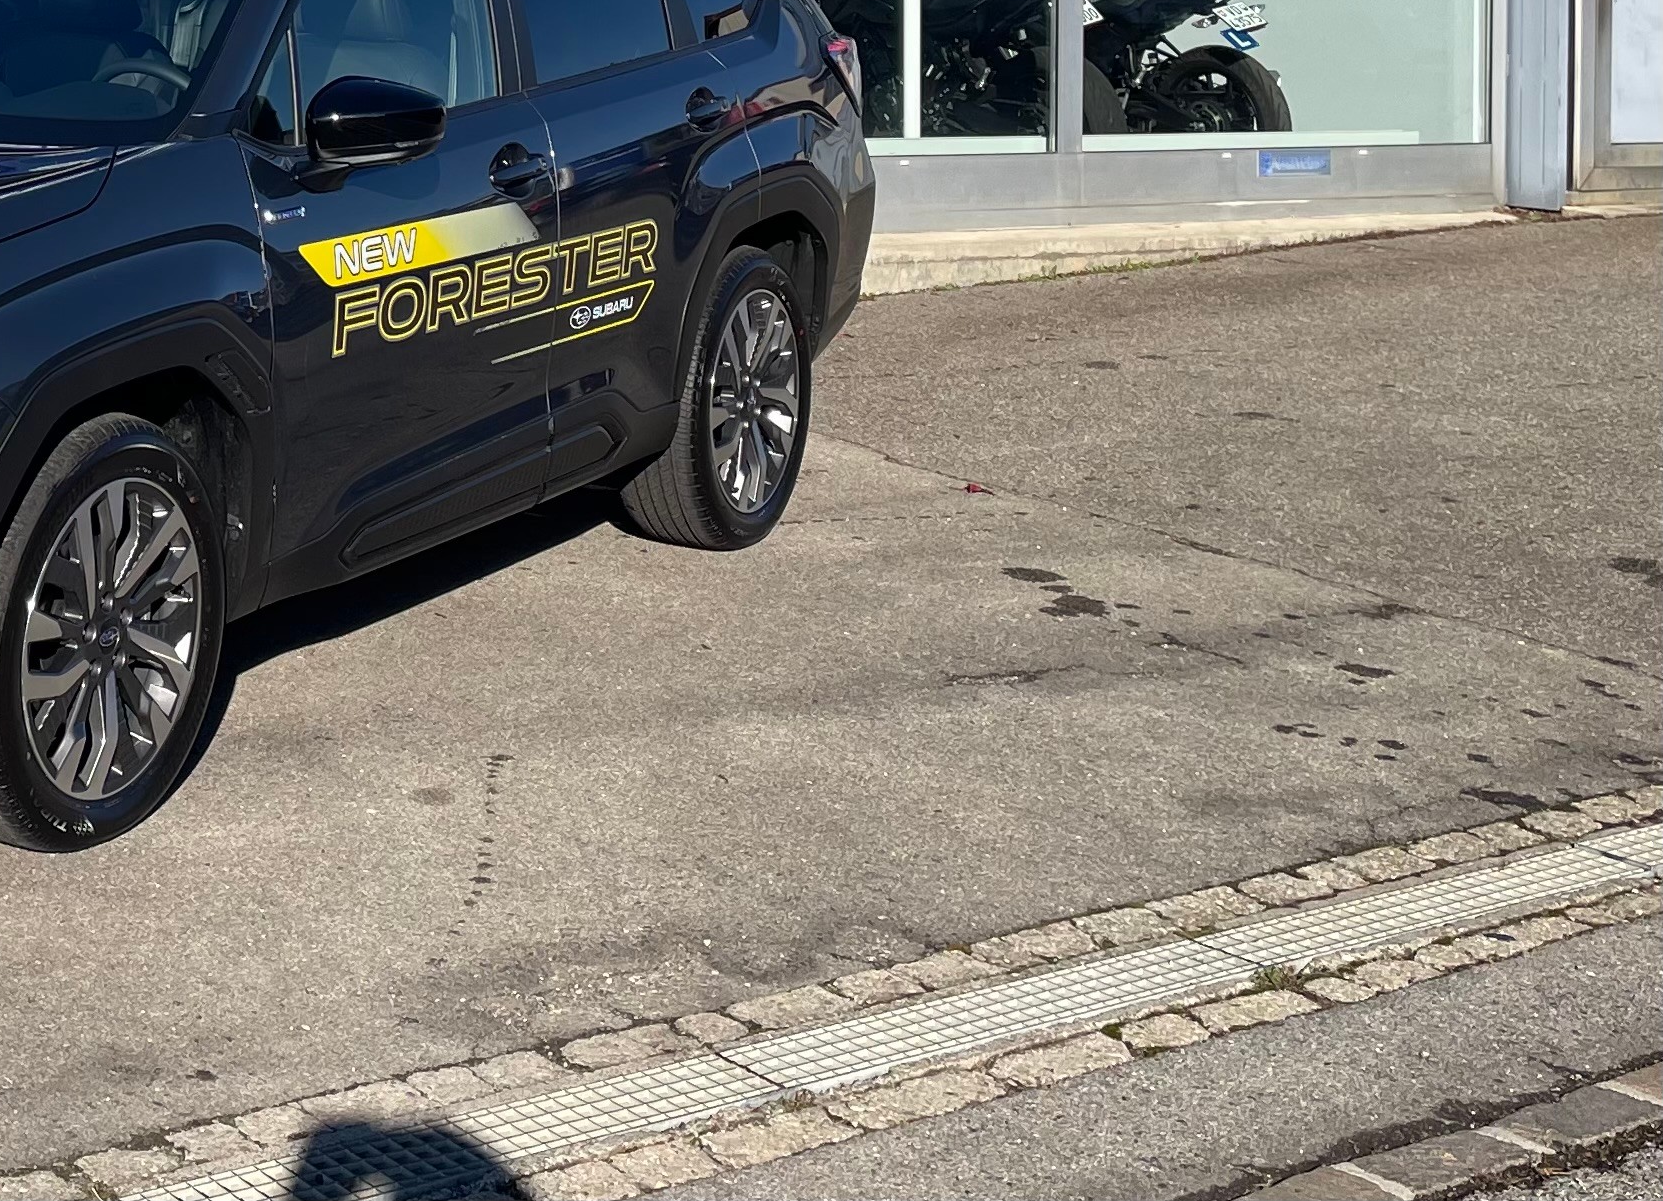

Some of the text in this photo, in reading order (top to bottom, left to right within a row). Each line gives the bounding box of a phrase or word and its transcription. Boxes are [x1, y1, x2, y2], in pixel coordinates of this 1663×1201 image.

[1227, 31, 1252, 47] L
[334, 227, 417, 279] NEW
[331, 219, 658, 358] FORESTER
[592, 295, 634, 319] SUBARU
